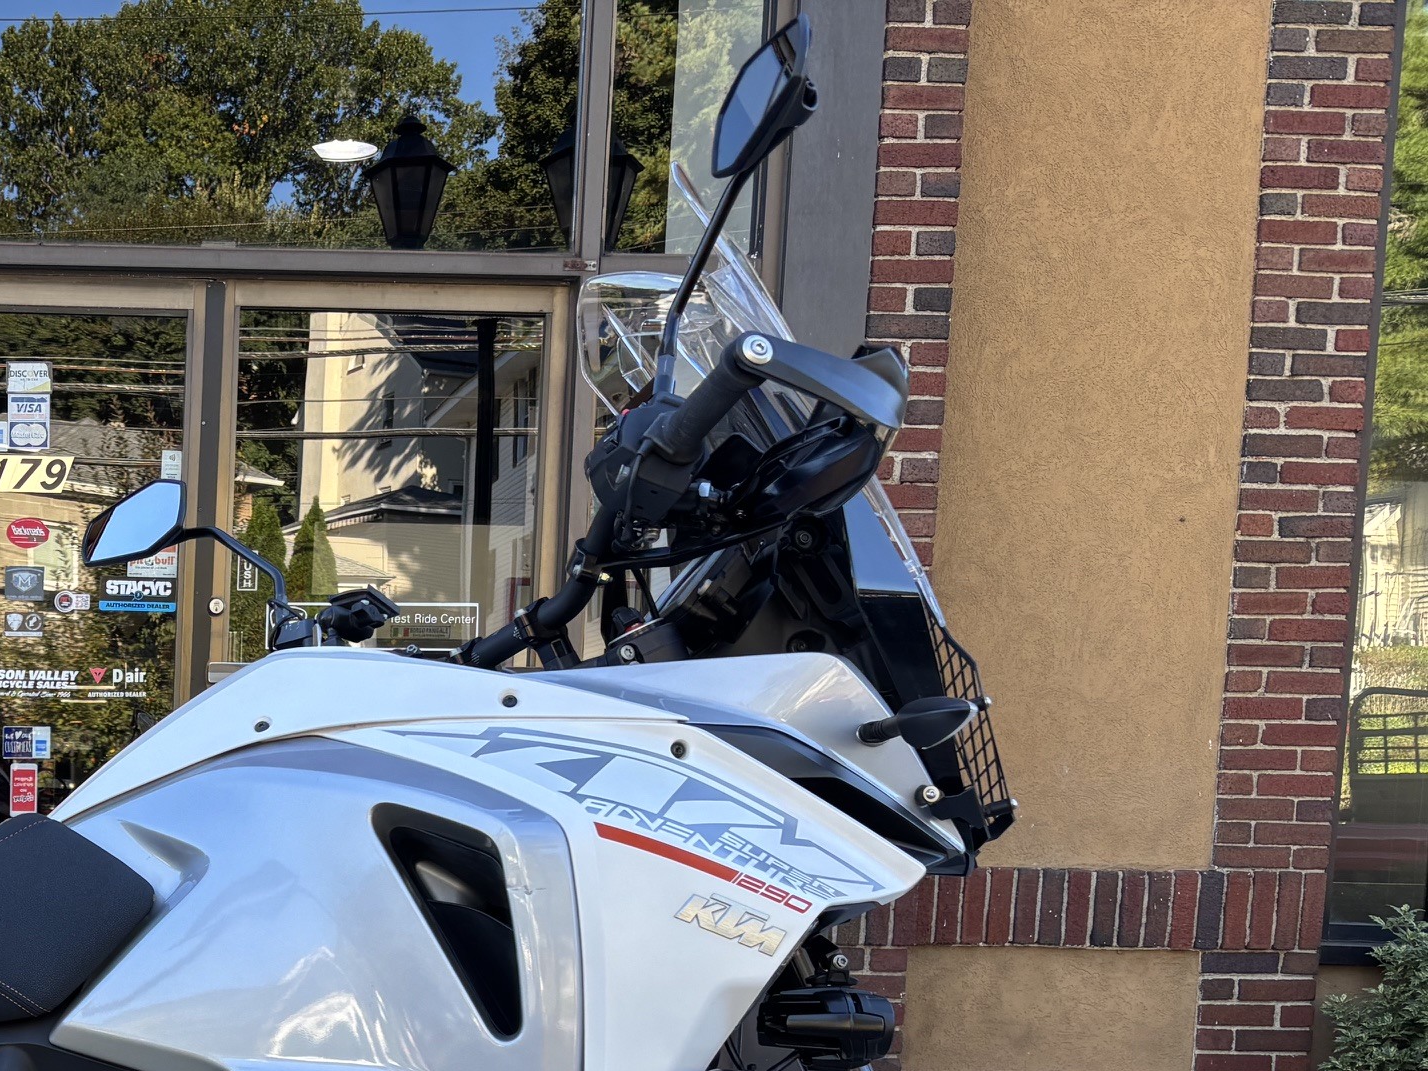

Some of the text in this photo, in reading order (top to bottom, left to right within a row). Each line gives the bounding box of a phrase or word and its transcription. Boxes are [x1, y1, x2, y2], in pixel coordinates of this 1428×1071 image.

[16, 404, 42, 413] VISA
[243, 559, 252, 588] USH
[106, 580, 172, 596] STACYC
[414, 613, 437, 624] Ride
[440, 613, 475, 624] Center
[29, 670, 79, 682] VALLEY
[36, 681, 68, 689] SALES
[581, 799, 836, 900] ADVENTURE
[719, 829, 846, 897] SUPER
[732, 872, 813, 914] 1290
[673, 893, 787, 956] KTM
